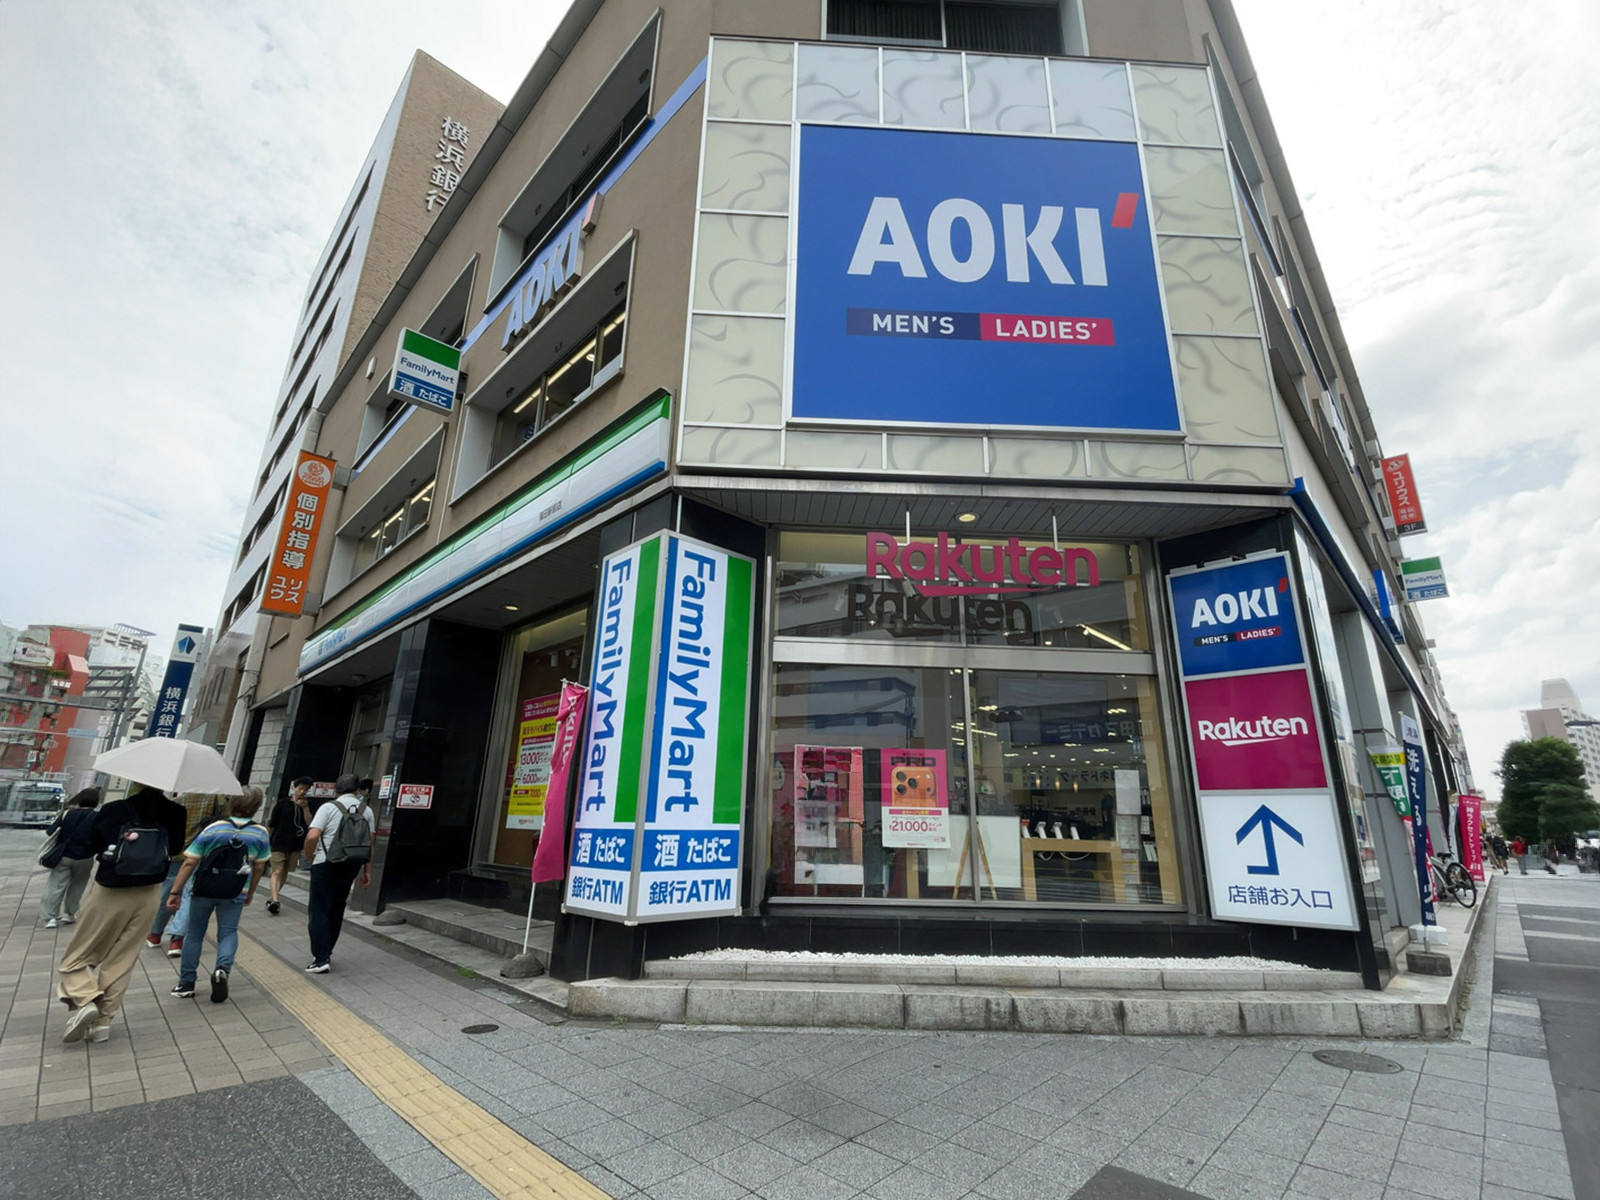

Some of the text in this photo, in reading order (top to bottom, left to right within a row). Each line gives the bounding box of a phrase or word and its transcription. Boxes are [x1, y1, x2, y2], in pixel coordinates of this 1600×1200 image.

[426, 115, 471, 212] 横浜銀行
[847, 195, 1109, 287] AOKI
[502, 219, 585, 353] AOKI
[873, 313, 1098, 340] MEN'S LADIES'
[400, 356, 455, 385] FamilyMart
[419, 388, 448, 407] たばこ
[281, 491, 319, 571] 個別指導
[866, 531, 1100, 587] Rakuten
[1191, 585, 1280, 628] AOKI
[1201, 628, 1277, 645] MEN'S LADIES'
[586, 557, 633, 812] FamilyMart
[664, 549, 717, 813] FamilyMart
[154, 686, 183, 738] 横浜銀行
[1198, 716, 1309, 742] Rakuten
[891, 756, 936, 766] PRO
[576, 832, 627, 865] 酒 たばこ
[653, 833, 731, 868] 酒 たばこ
[571, 875, 625, 906] 銀行ATM
[648, 878, 732, 906] 銀行ATM
[1227, 884, 1333, 910] 店舗お入口
